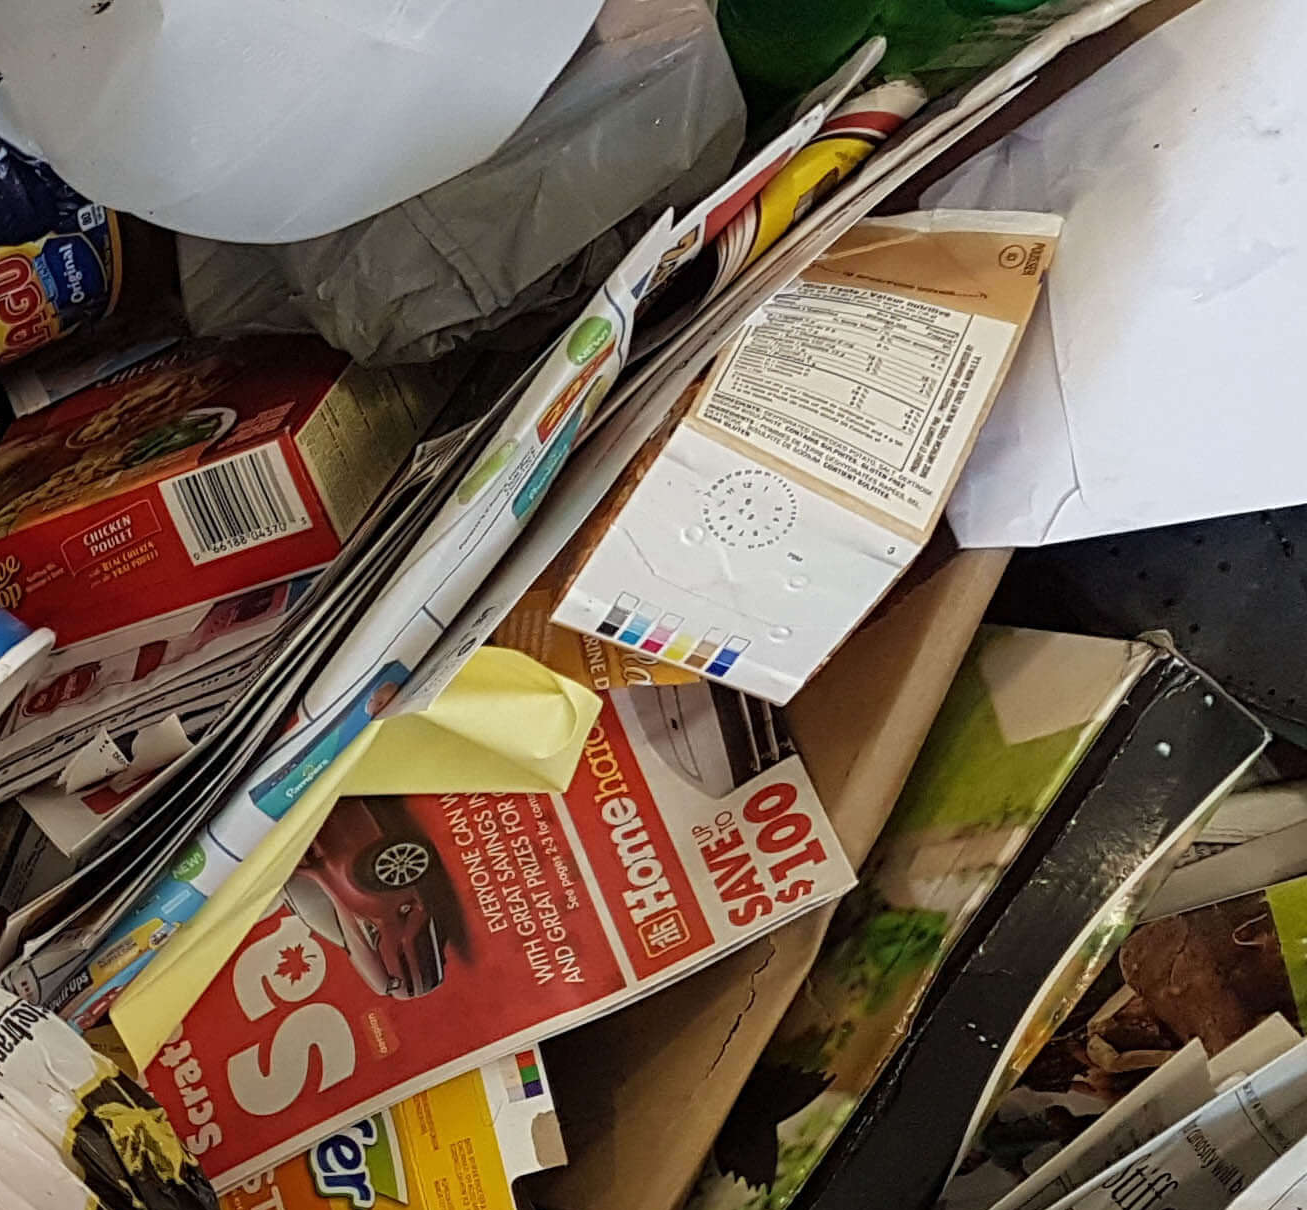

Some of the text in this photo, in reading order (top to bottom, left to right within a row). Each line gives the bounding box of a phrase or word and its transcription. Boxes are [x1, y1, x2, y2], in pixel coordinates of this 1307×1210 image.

[58, 242, 86, 303] Original
[82, 513, 133, 547] CHICKEN
[90, 528, 134, 558] POULET
[445, 808, 508, 934] EVERYONE CAN
[473, 809, 556, 985] WITH GREAT SAVINGS
[497, 803, 586, 984] AND GREAT PRIZES FOR
[551, 855, 580, 910] See pages
[600, 795, 679, 925] Home
[691, 810, 773, 927] SAVE UP TO
[741, 782, 828, 905] $100
